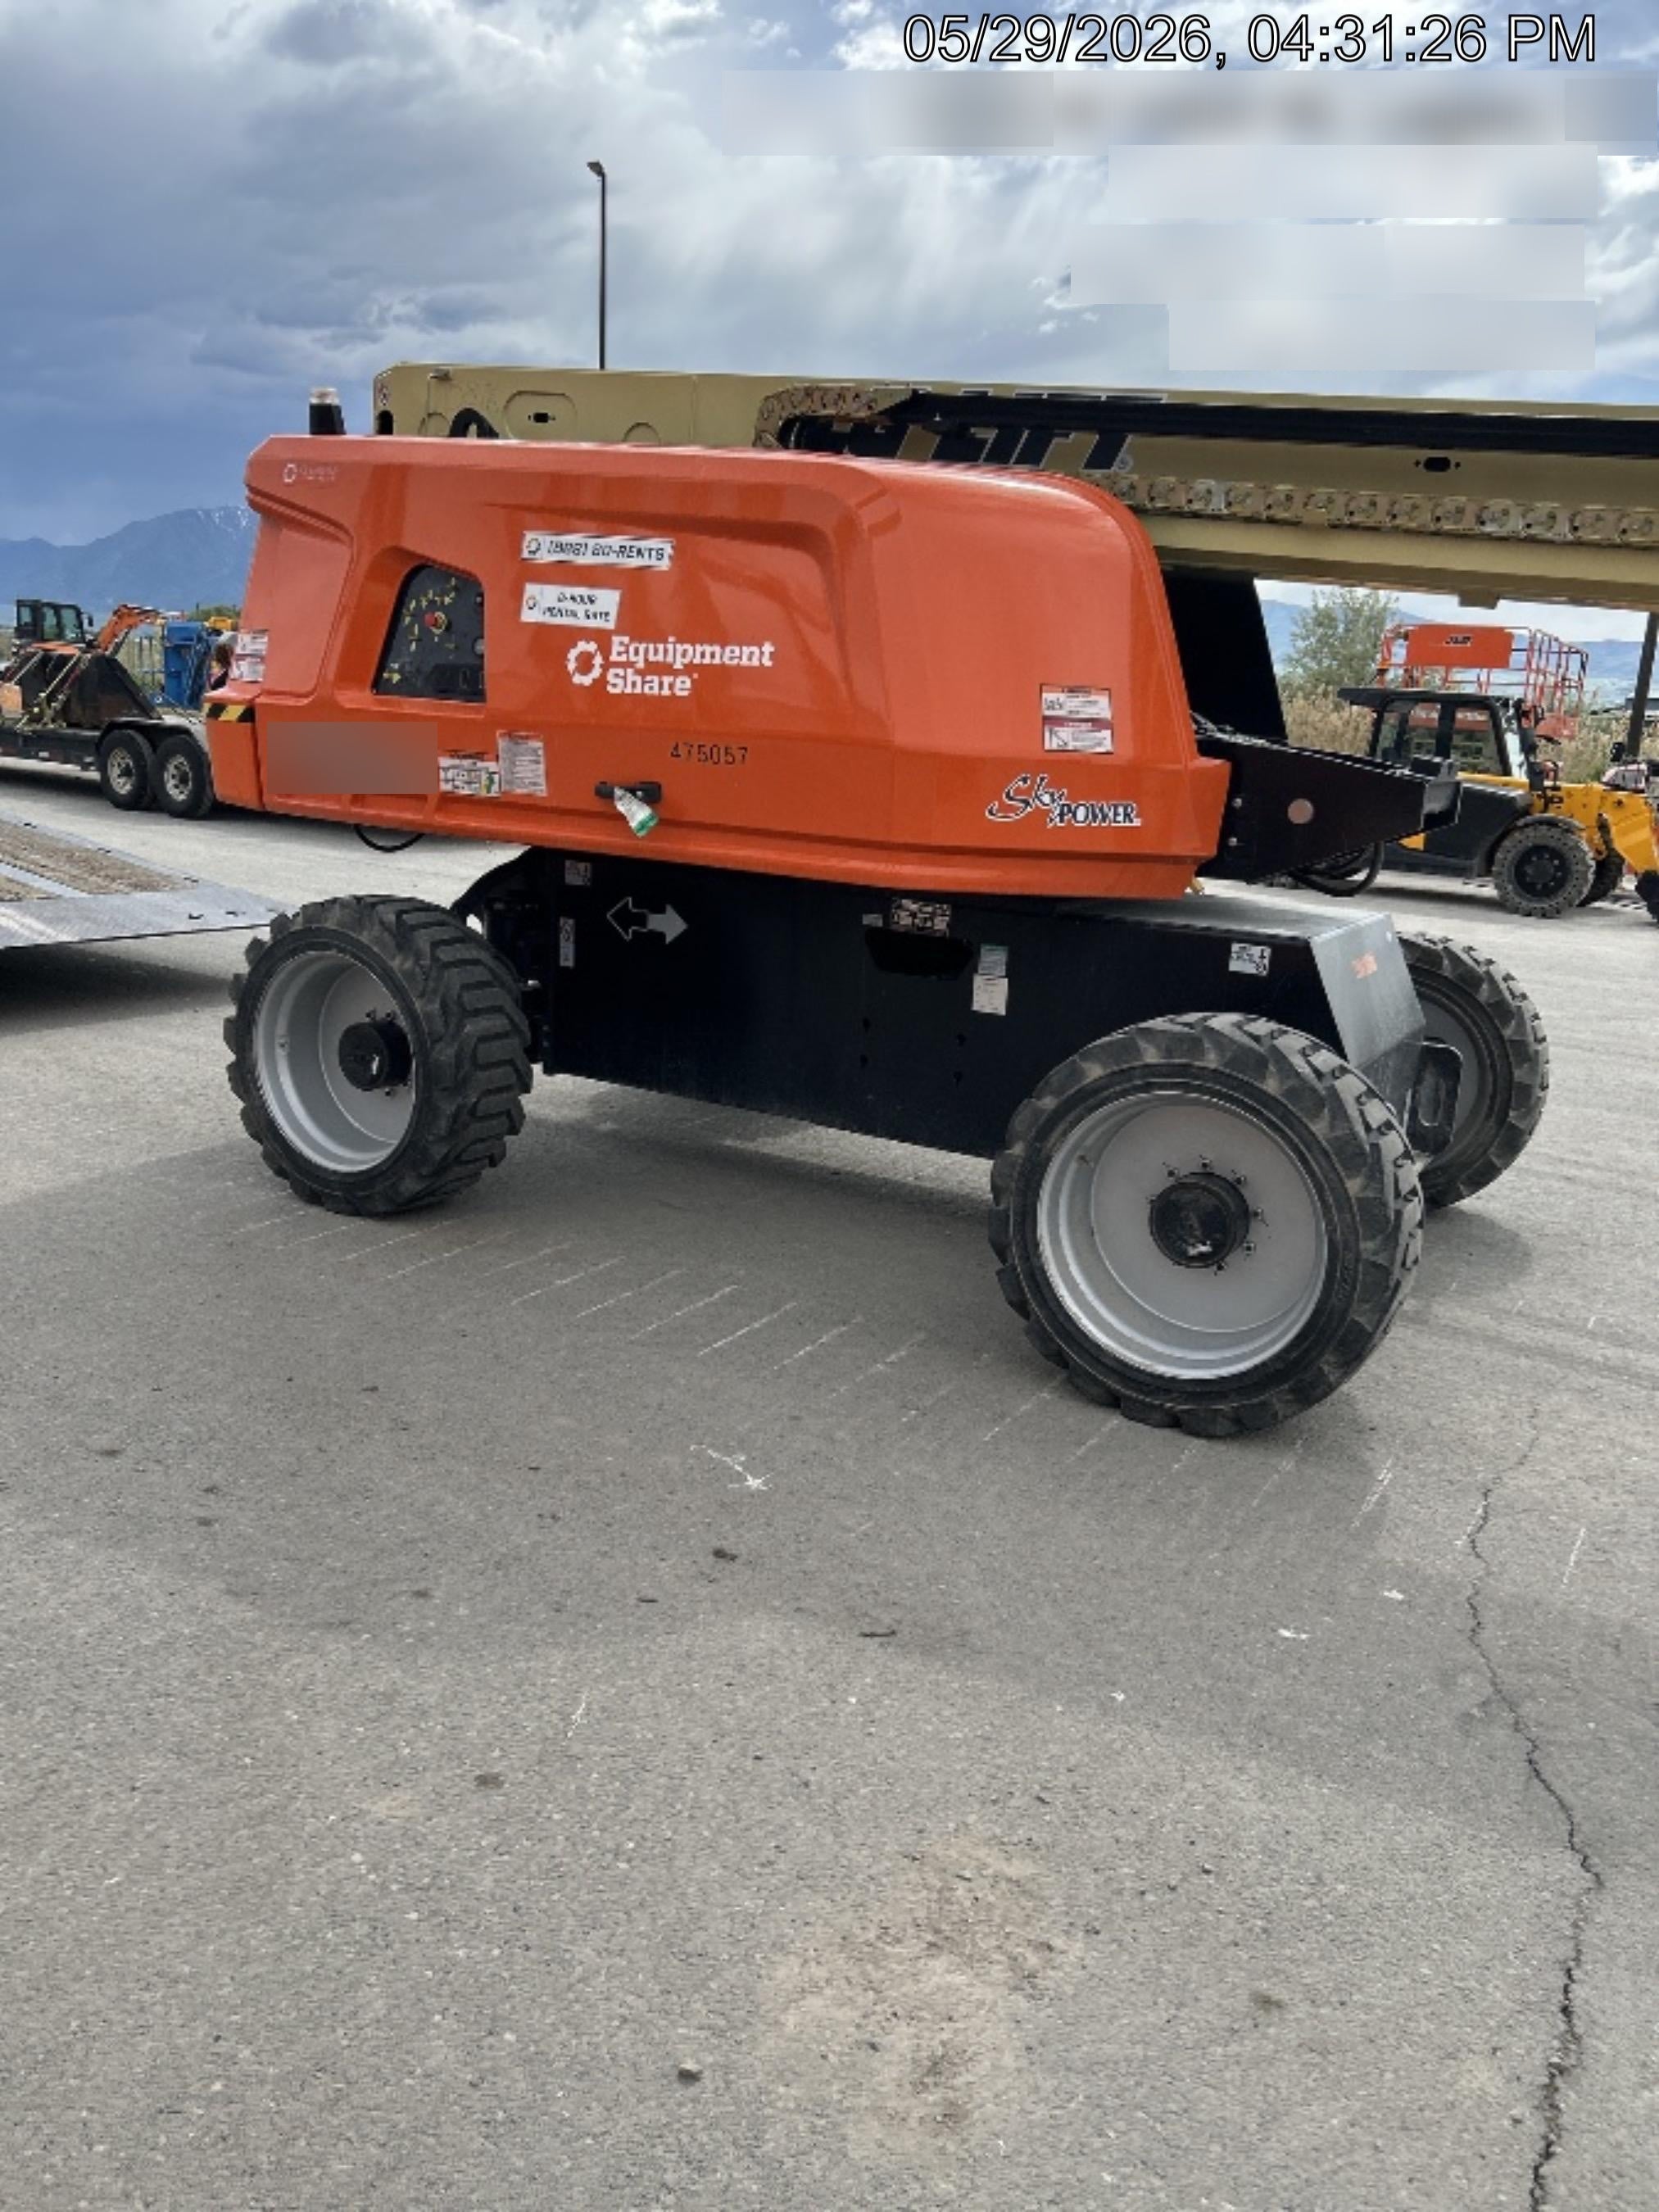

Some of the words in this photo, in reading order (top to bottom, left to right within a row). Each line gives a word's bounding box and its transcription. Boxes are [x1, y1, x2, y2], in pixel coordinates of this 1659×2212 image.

[610, 636, 775, 669] Equipment
[606, 668, 692, 696] Share
[670, 741, 748, 765] 475057
[986, 774, 1067, 828] Sky
[1056, 800, 1141, 827] POWER
